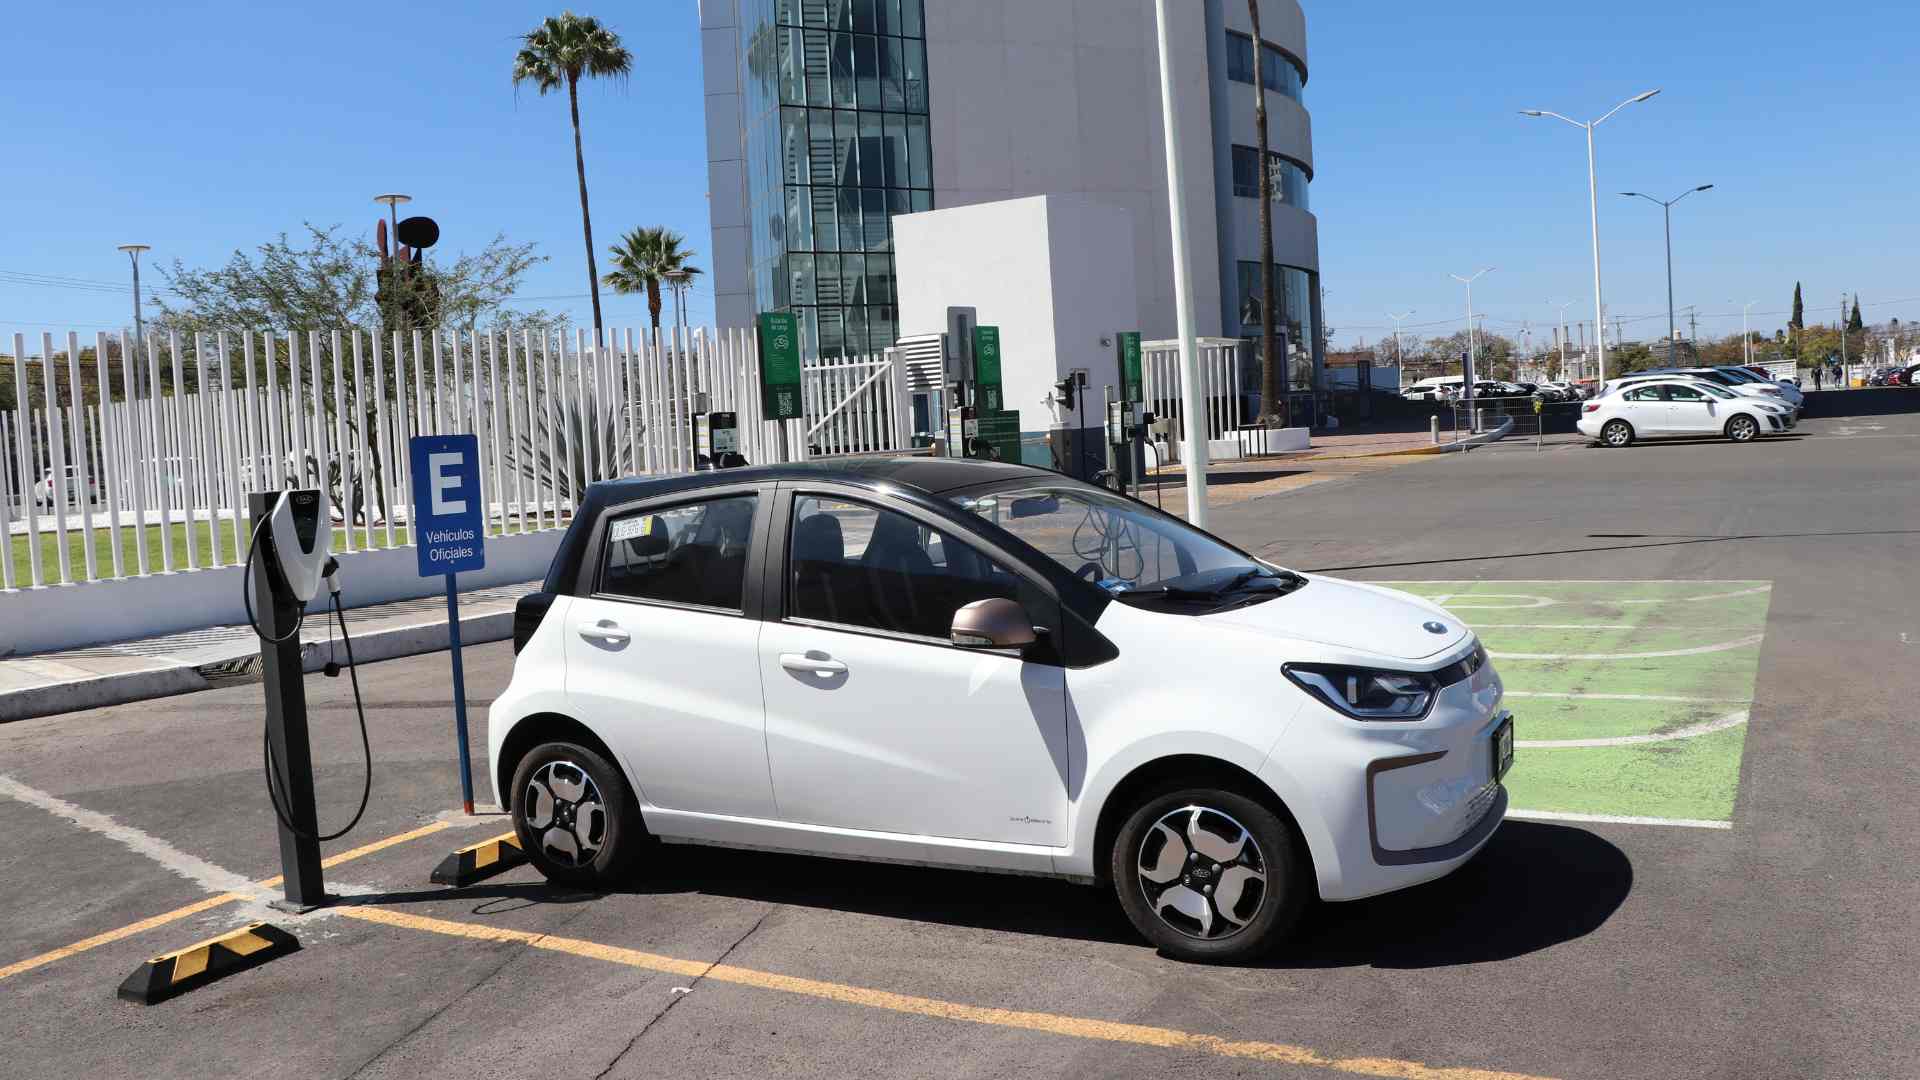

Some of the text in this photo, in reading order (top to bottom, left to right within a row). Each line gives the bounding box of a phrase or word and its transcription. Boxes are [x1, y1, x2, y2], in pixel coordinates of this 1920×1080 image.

[429, 452, 467, 516] E
[425, 528, 475, 545] Vehículos
[429, 546, 473, 561] Oficiales
